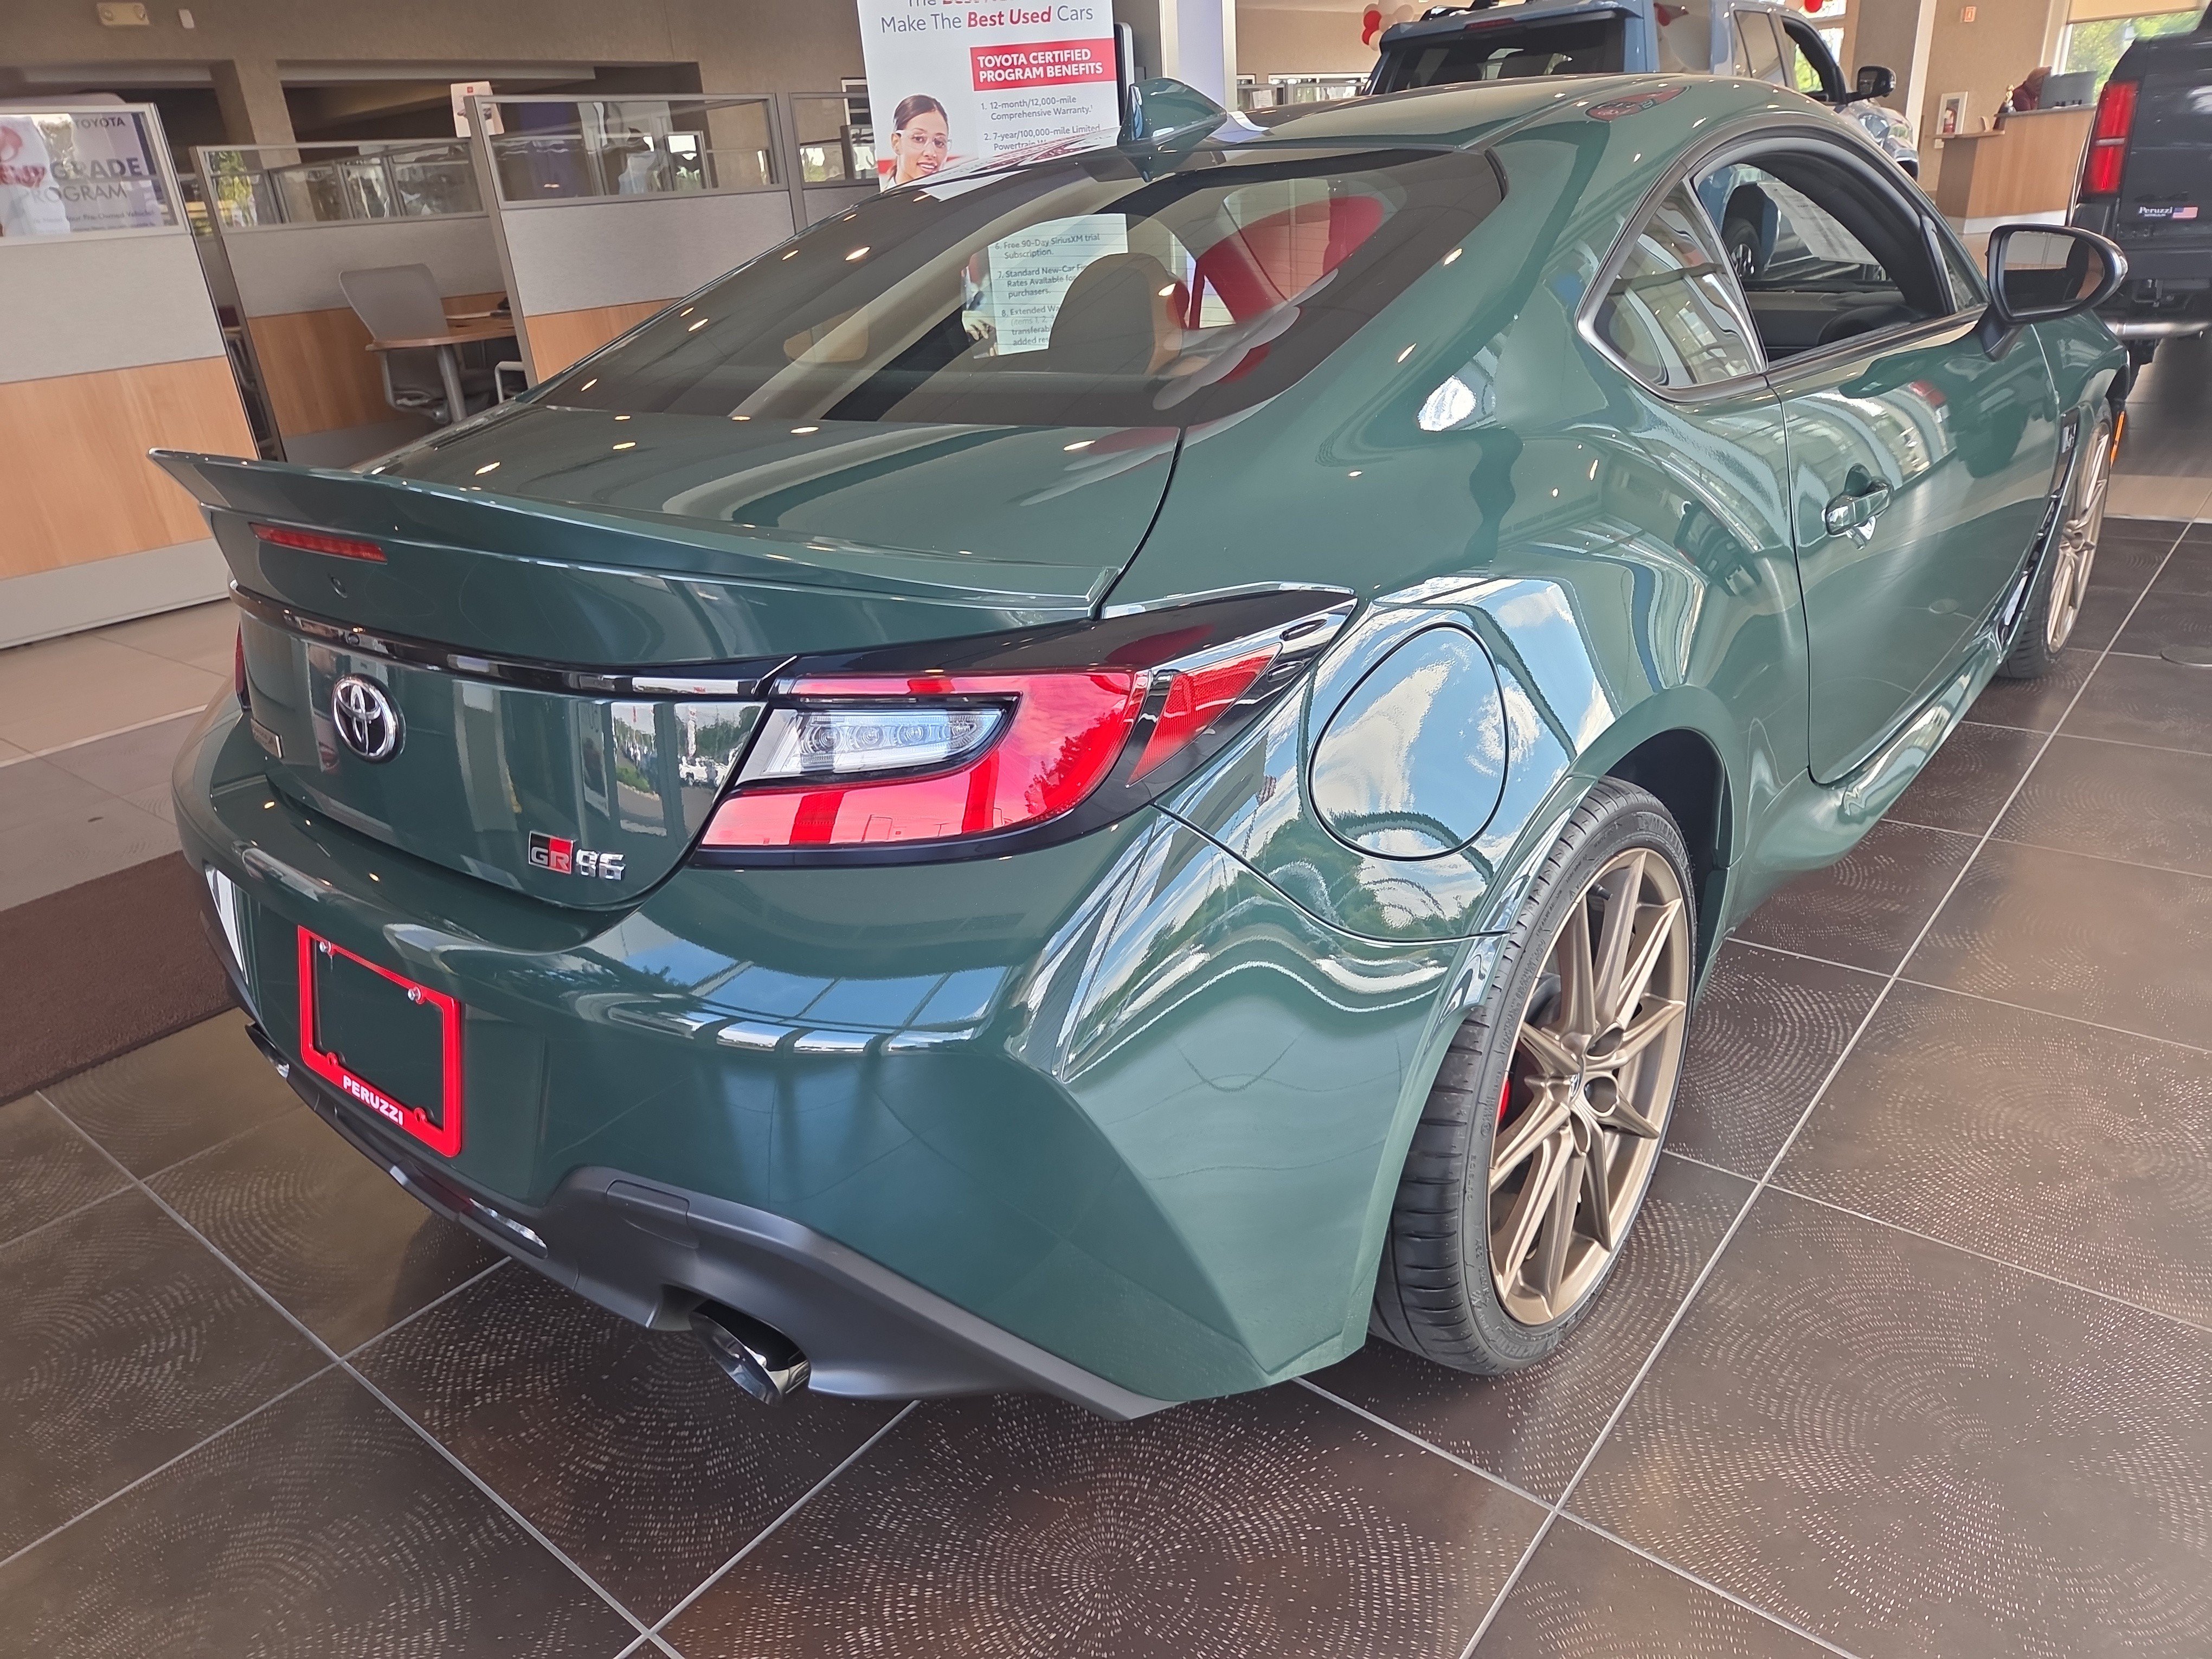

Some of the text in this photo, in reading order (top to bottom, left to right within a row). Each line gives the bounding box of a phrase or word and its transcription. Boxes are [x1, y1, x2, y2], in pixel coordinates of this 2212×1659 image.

[881, 5, 1093, 33] Make The Best Used Cars
[977, 49, 1091, 68] TOYOTA CERTIFIED
[979, 62, 1103, 83] PROGRAM BENEFITS
[990, 95, 1077, 109] 12-month/12,000-mile
[991, 110, 1052, 121] Comprehensive
[993, 127, 1070, 141] 7-year/100,000-mile
[1072, 124, 1100, 134] Limited
[2138, 206, 2173, 214] Peruzzi
[1004, 241, 1020, 249] Free
[1021, 239, 1049, 248] 90-Day
[1051, 235, 1083, 245] SiriusXM
[1085, 233, 1100, 242] trial
[1005, 249, 1054, 259] Subscription.
[1006, 268, 1040, 278] Standard
[1041, 265, 1075, 274] New-Car
[1031, 276, 1064, 285] Available
[1008, 288, 1052, 300] purchasers.
[1010, 306, 1046, 316] Extended
[1013, 337, 1037, 346] added
[531, 846, 569, 870] GR
[343, 1075, 403, 1126] PERUZZI
